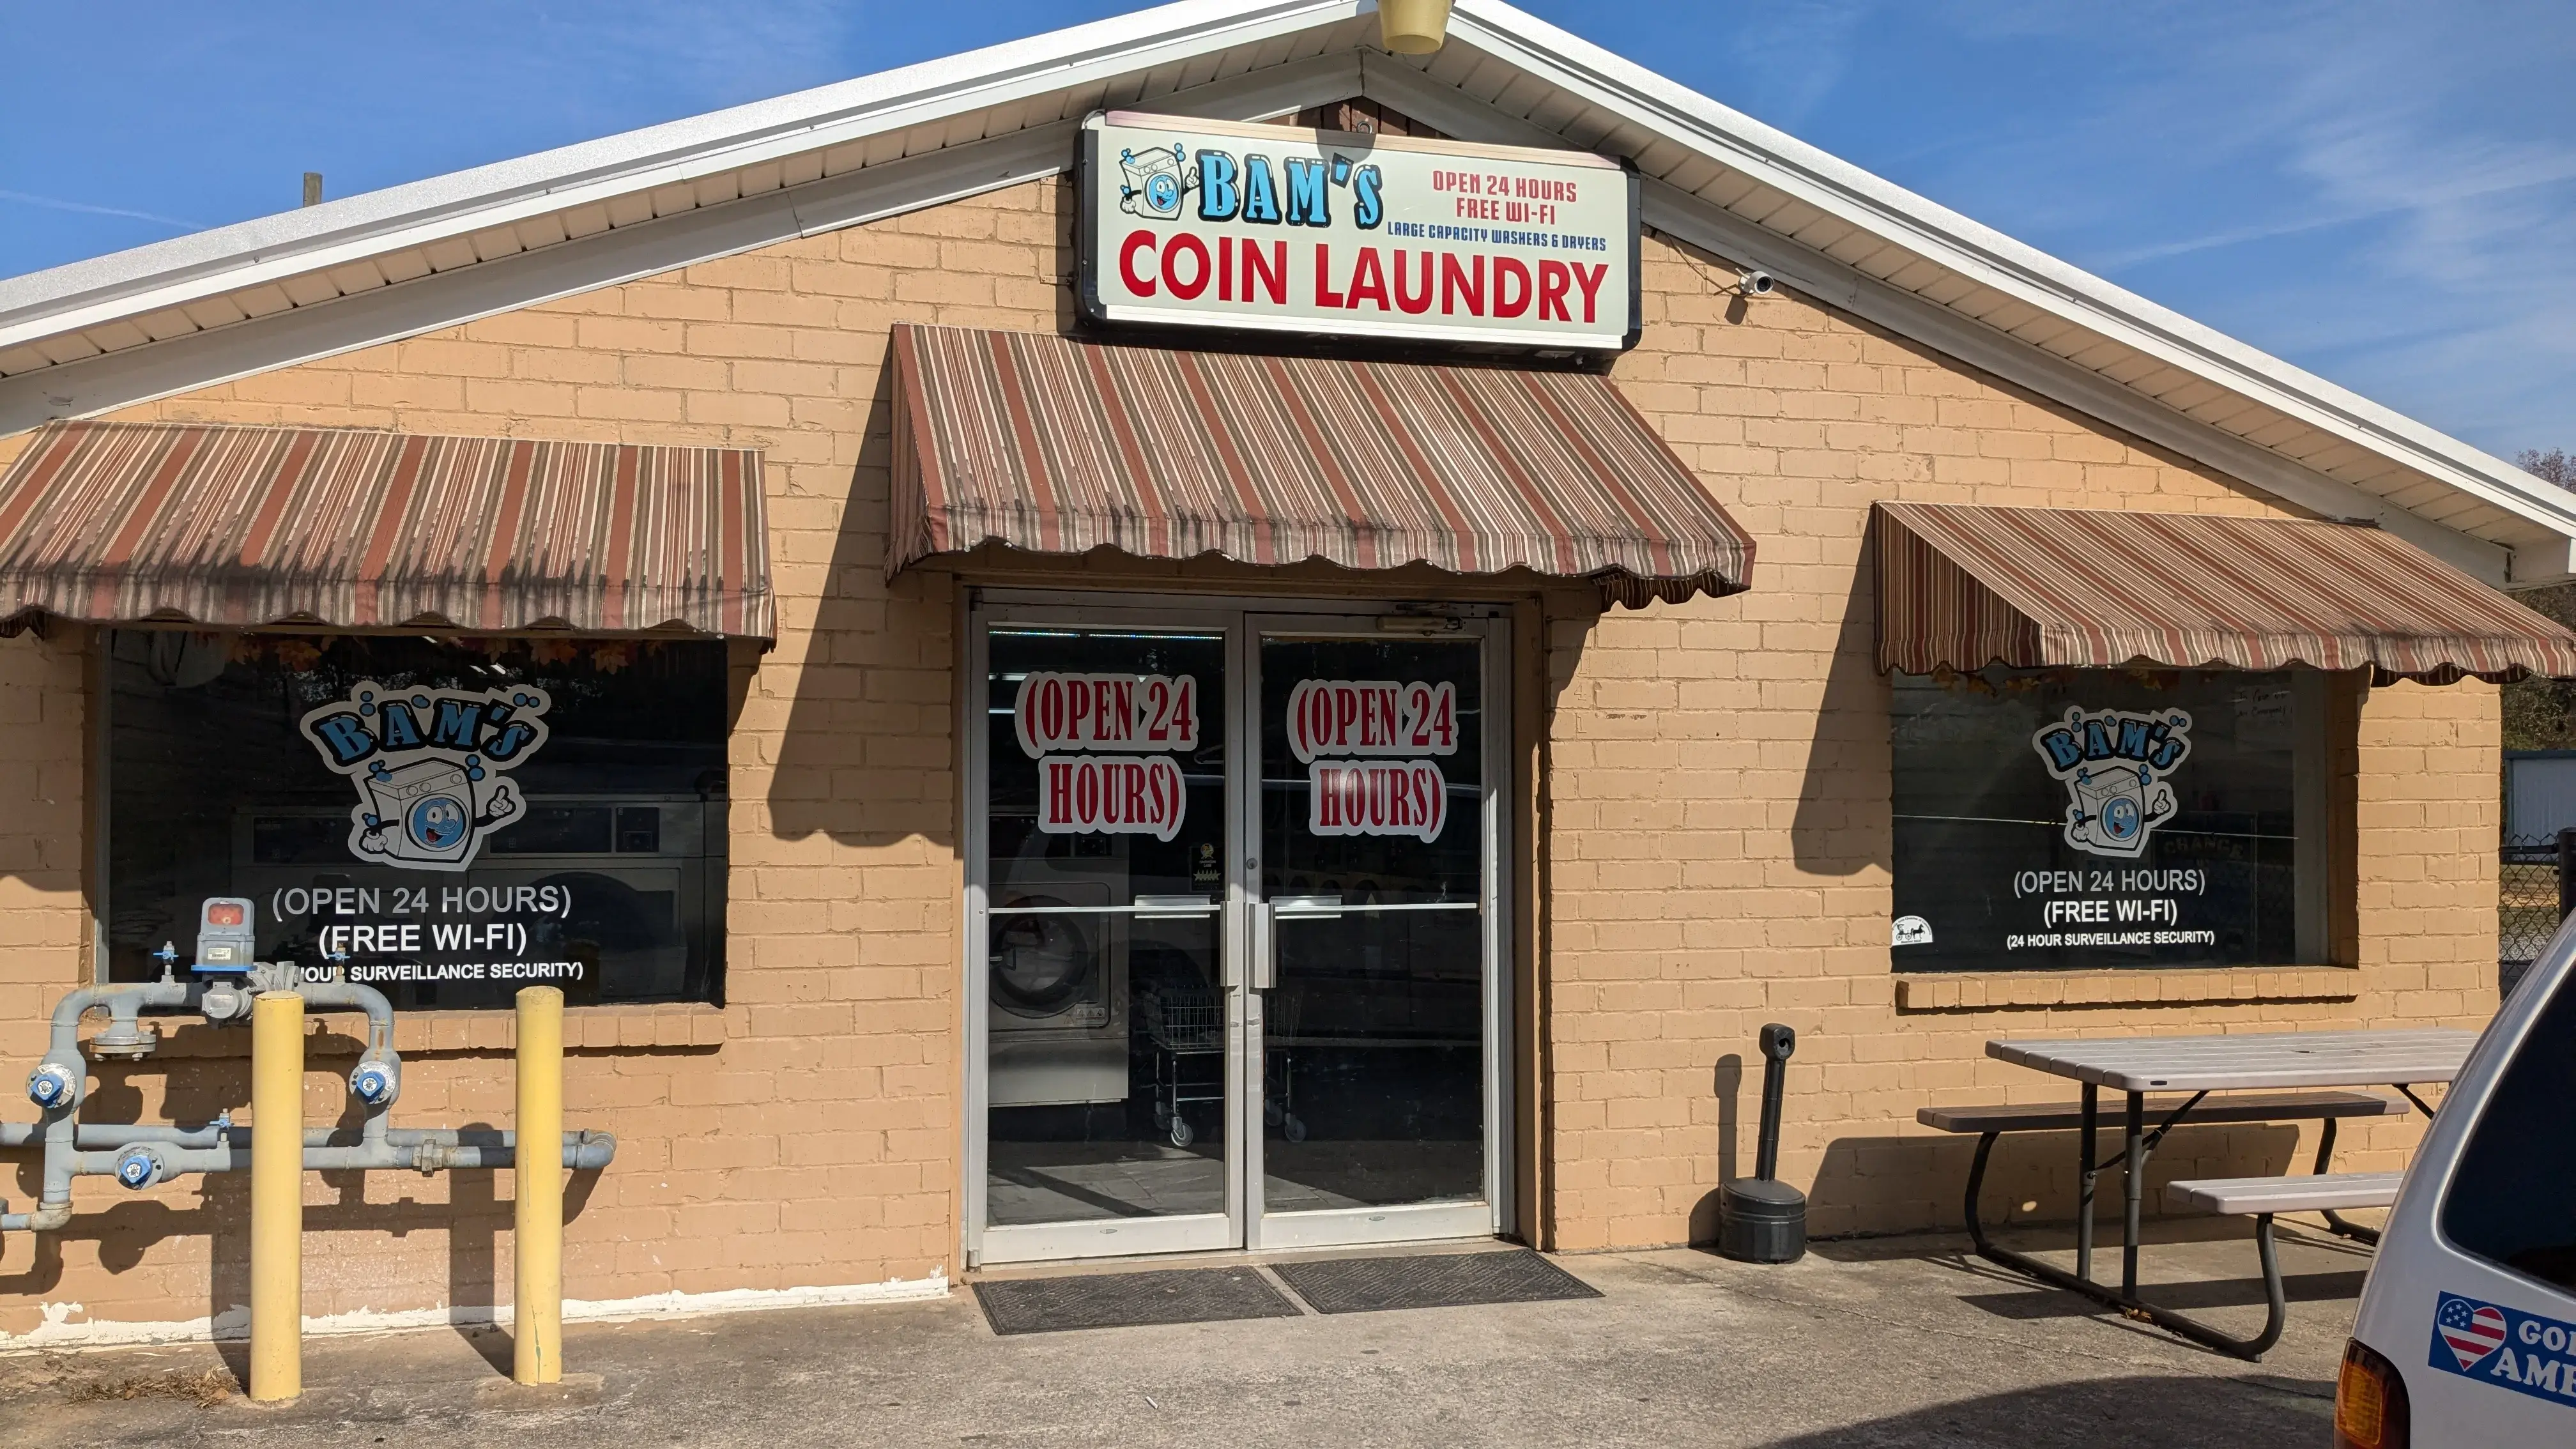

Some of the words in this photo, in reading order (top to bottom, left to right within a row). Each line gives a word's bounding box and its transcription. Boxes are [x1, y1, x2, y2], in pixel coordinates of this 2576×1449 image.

[1197, 149, 1383, 230] BAM'S
[1432, 170, 1480, 194] OPEN
[1487, 175, 1510, 197] 24
[1515, 177, 1577, 203] HOURS
[1456, 197, 1499, 220] FREE
[1505, 201, 1555, 225] WI-FI
[1387, 221, 1425, 238] LARGE
[1428, 224, 1488, 243] CAPACITY
[1491, 230, 1548, 248] WASHERS
[1551, 234, 1558, 248] &
[1561, 236, 1607, 252] DRYERS
[1119, 229, 1288, 305] COIN
[1314, 243, 1609, 325] LAUNDRY
[310, 697, 538, 768] BAM'S
[1025, 679, 1133, 749] (OPEN
[1148, 680, 1192, 741] 24
[1296, 687, 1398, 754] (OPEN
[1411, 689, 1452, 746] 24
[2040, 717, 2186, 772] BAM'S
[1048, 763, 1179, 832] HOURS)
[1319, 768, 1441, 834] HOURS)
[2014, 871, 2083, 899] (OPEN
[2089, 870, 2114, 892] 24
[2122, 869, 2205, 896] HOURS)
[272, 887, 380, 923] (OPEN
[392, 887, 429, 914] 24
[441, 885, 572, 919] HOURS)
[2044, 900, 2110, 929] (FREE
[2115, 898, 2177, 926] WI-FI)
[319, 924, 421, 960] (FREE
[431, 923, 526, 956] WI-FI)
[2007, 935, 2025, 951] (24
[2027, 933, 2062, 947] HOUR
[2064, 931, 2151, 946] SURVEILLANCE
[2153, 930, 2215, 946] SECURITY)
[350, 963, 485, 982] SURVEILLANCE
[489, 962, 583, 980] SECURITY)
